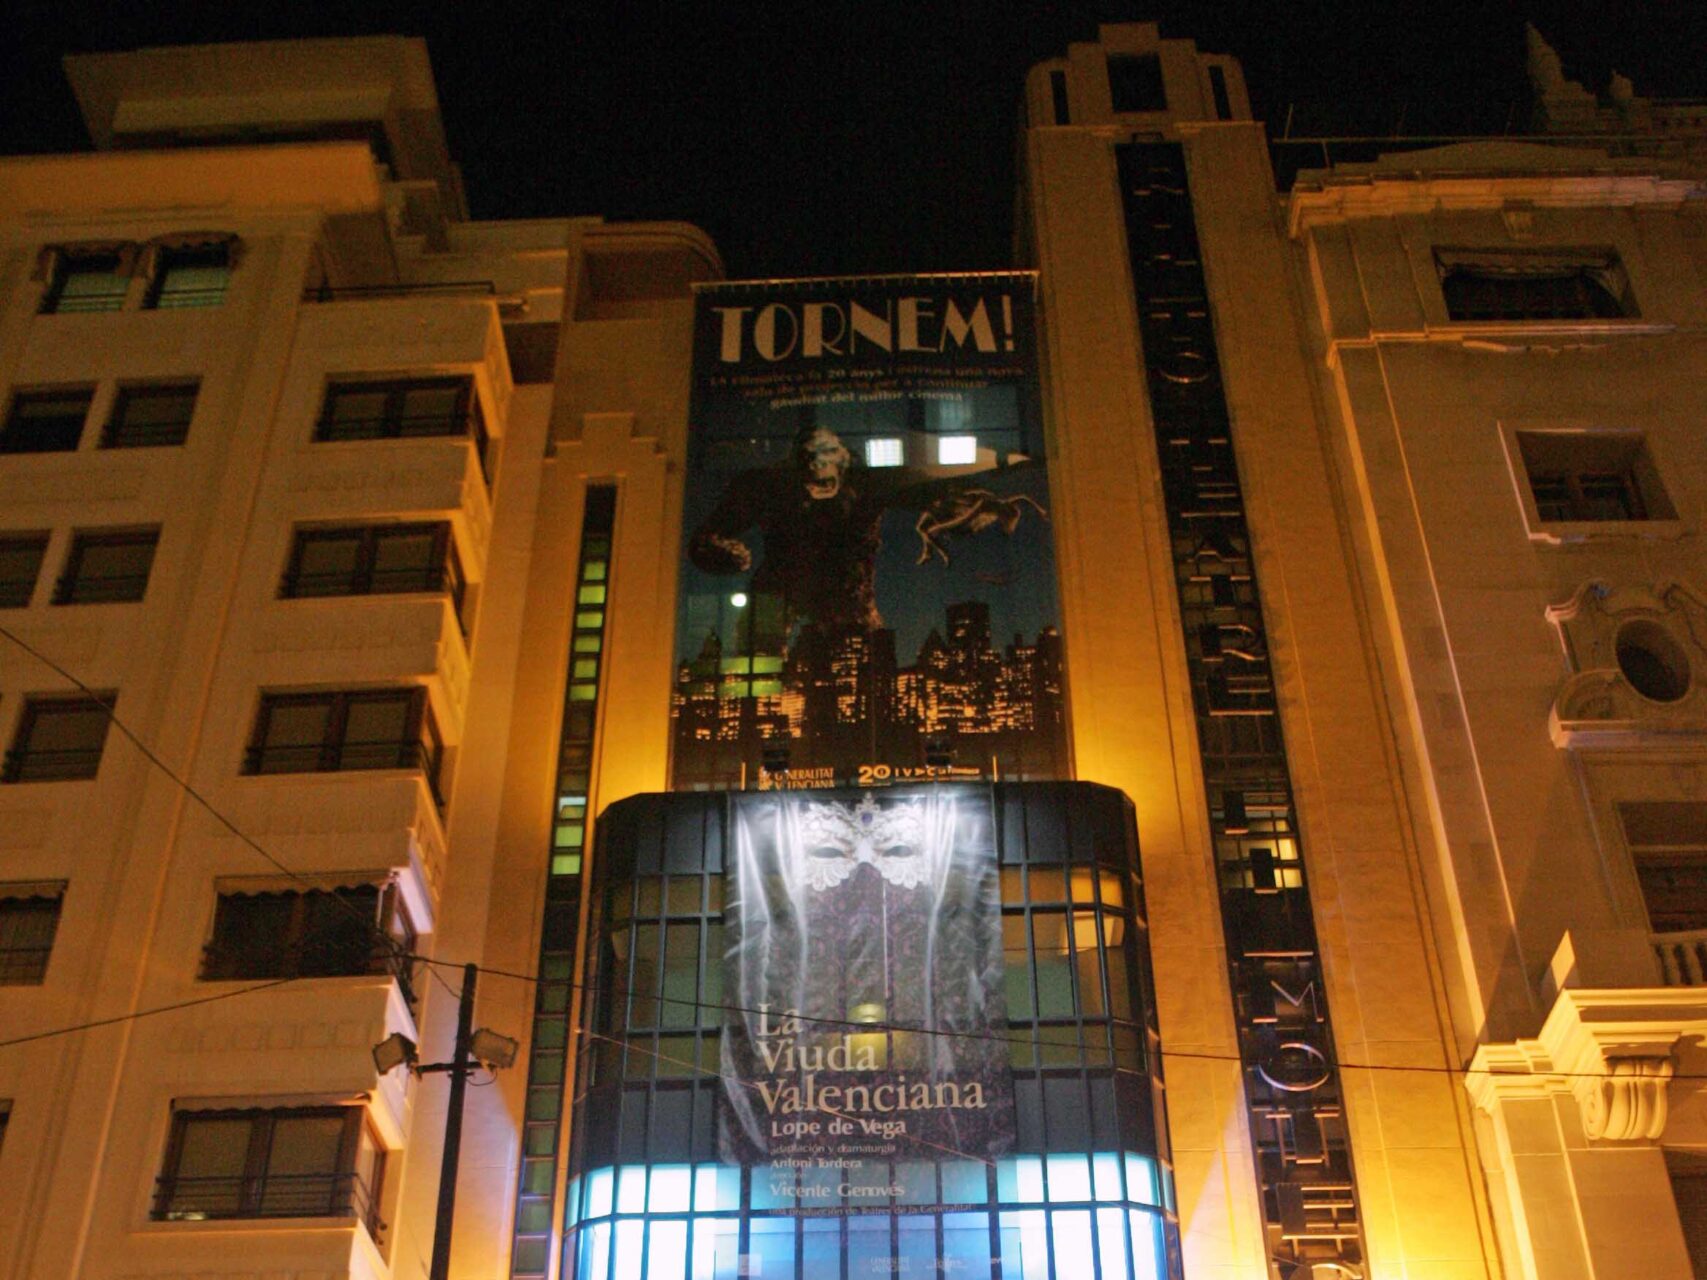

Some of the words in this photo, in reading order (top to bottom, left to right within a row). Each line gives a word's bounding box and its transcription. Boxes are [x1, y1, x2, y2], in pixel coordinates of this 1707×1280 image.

[711, 295, 1016, 363] TORNEM!
[775, 767, 834, 780] GNERALITAT
[758, 1003, 803, 1037] La
[758, 1035, 879, 1074] Viuda
[756, 1076, 987, 1115] Valenciana
[771, 1120, 821, 1140] Lope
[828, 1118, 854, 1135] de
[859, 1118, 907, 1140] Vega
[770, 1157, 812, 1170] Antoni
[817, 1157, 862, 1170] Tordera
[770, 1180, 831, 1198] Vicente
[837, 1181, 905, 1198] Genovés
